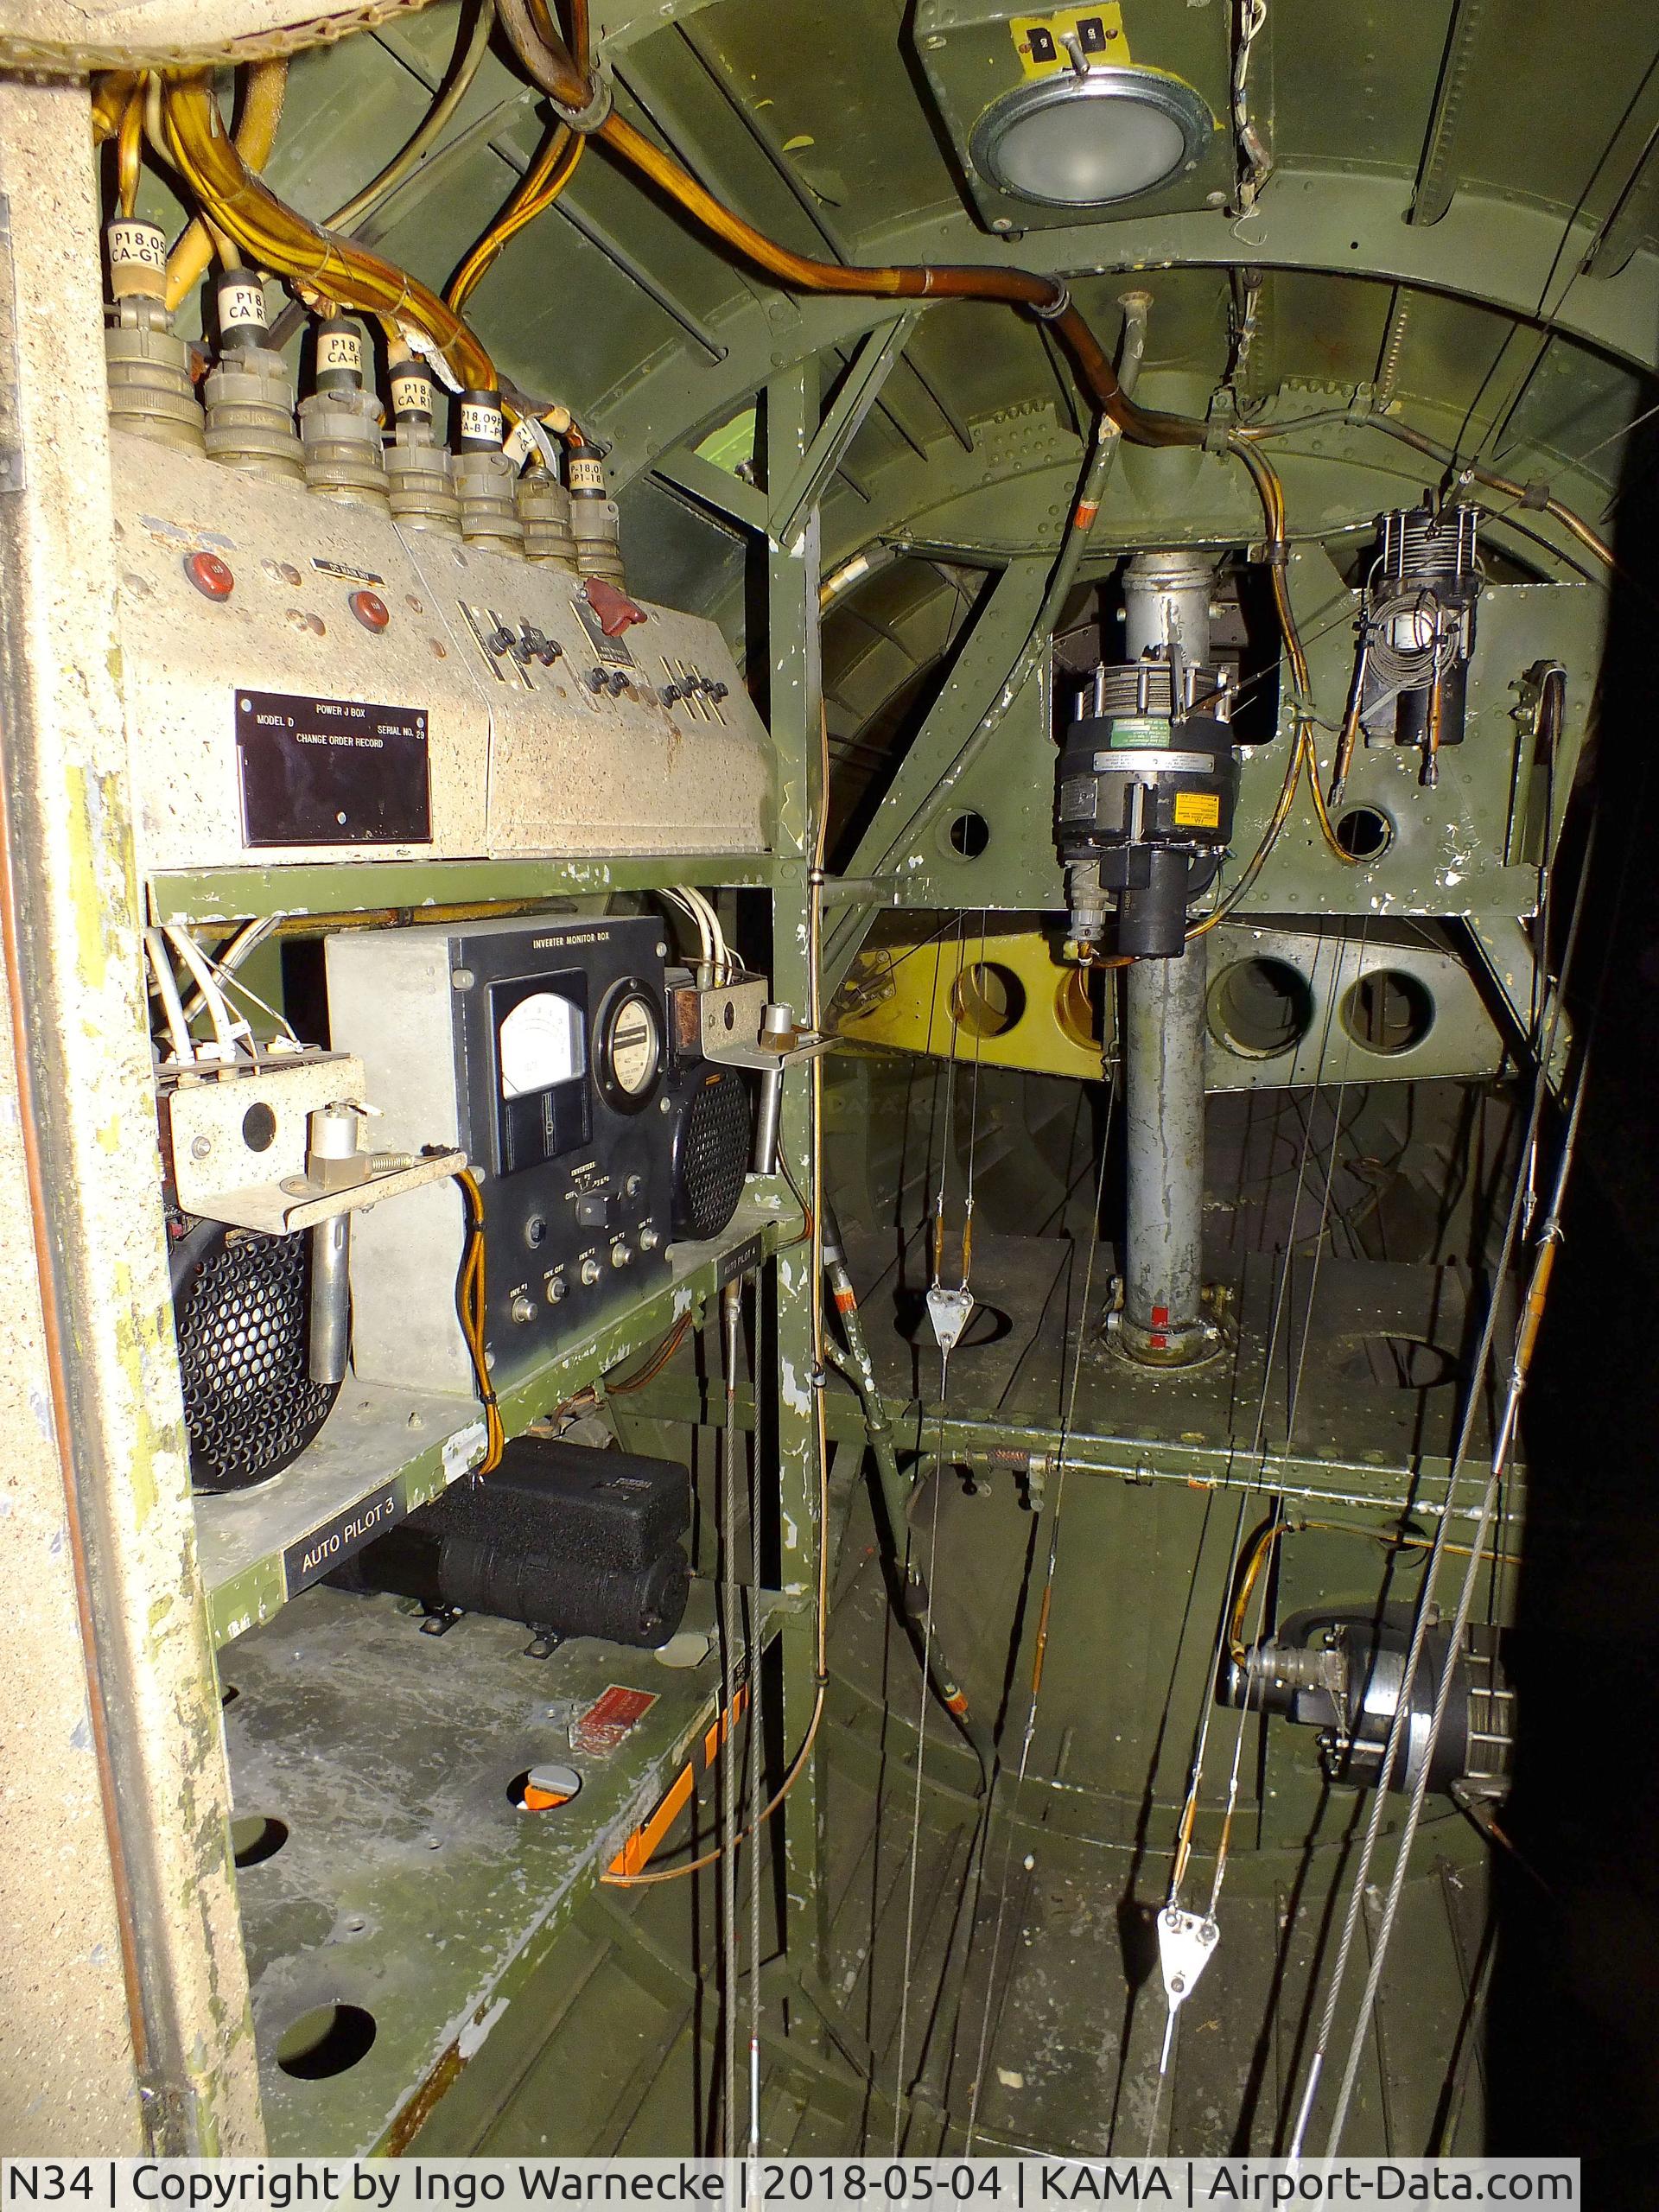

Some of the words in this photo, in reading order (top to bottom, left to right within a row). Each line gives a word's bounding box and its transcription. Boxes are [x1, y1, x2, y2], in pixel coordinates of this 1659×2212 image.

[1086, 28, 1096, 40] OFF
[1039, 37, 1048, 48] ON
[229, 306, 251, 318] CA
[397, 395, 415, 406] CA
[316, 703, 342, 716] POWER
[350, 708, 365, 718] BOX
[257, 714, 285, 727] MODEL
[287, 716, 295, 728] D
[377, 724, 401, 736] SERIAL
[416, 730, 425, 740] 29
[296, 733, 327, 745] CHANGE
[329, 736, 353, 747] ORDER
[355, 737, 384, 749] RECORD
[533, 937, 564, 949] INVERTER
[566, 933, 595, 945] MONITOR
[597, 931, 609, 941] BOX
[302, 1535, 340, 1573] AUTO
[344, 1503, 382, 1543] PILOT
[385, 1496, 395, 1515] 3
